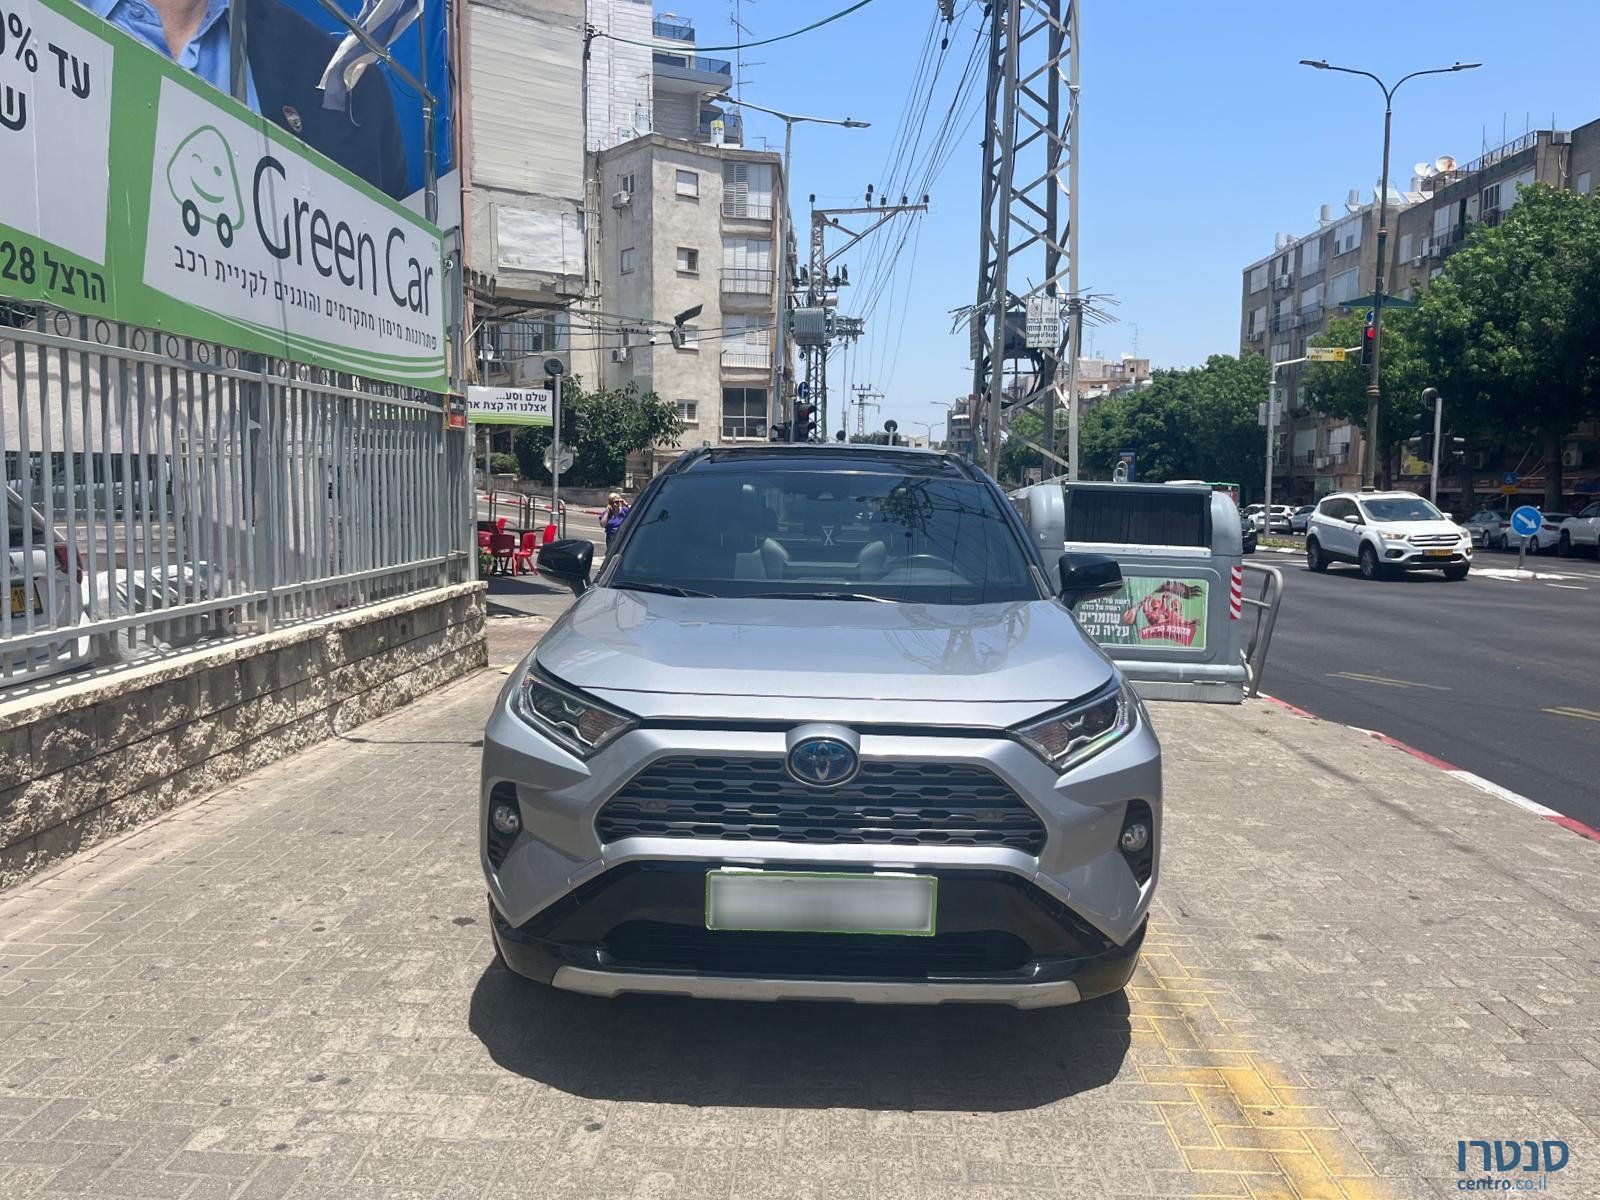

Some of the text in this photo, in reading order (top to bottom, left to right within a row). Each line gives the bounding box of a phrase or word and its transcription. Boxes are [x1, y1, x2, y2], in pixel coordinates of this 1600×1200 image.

[48, 42, 90, 99] עד
[253, 155, 433, 316] Green Car
[0, 241, 105, 303] הרצל 28
[174, 245, 437, 350] פתרונות מימון מתקדמים והוגנים לקניית רכב
[525, 392, 547, 402] שלם
[482, 401, 504, 412] קצת
[506, 402, 518, 411] זה
[520, 402, 547, 412] אצלנו
[1079, 611, 1121, 624] שומרים
[1103, 624, 1130, 637] עליה
